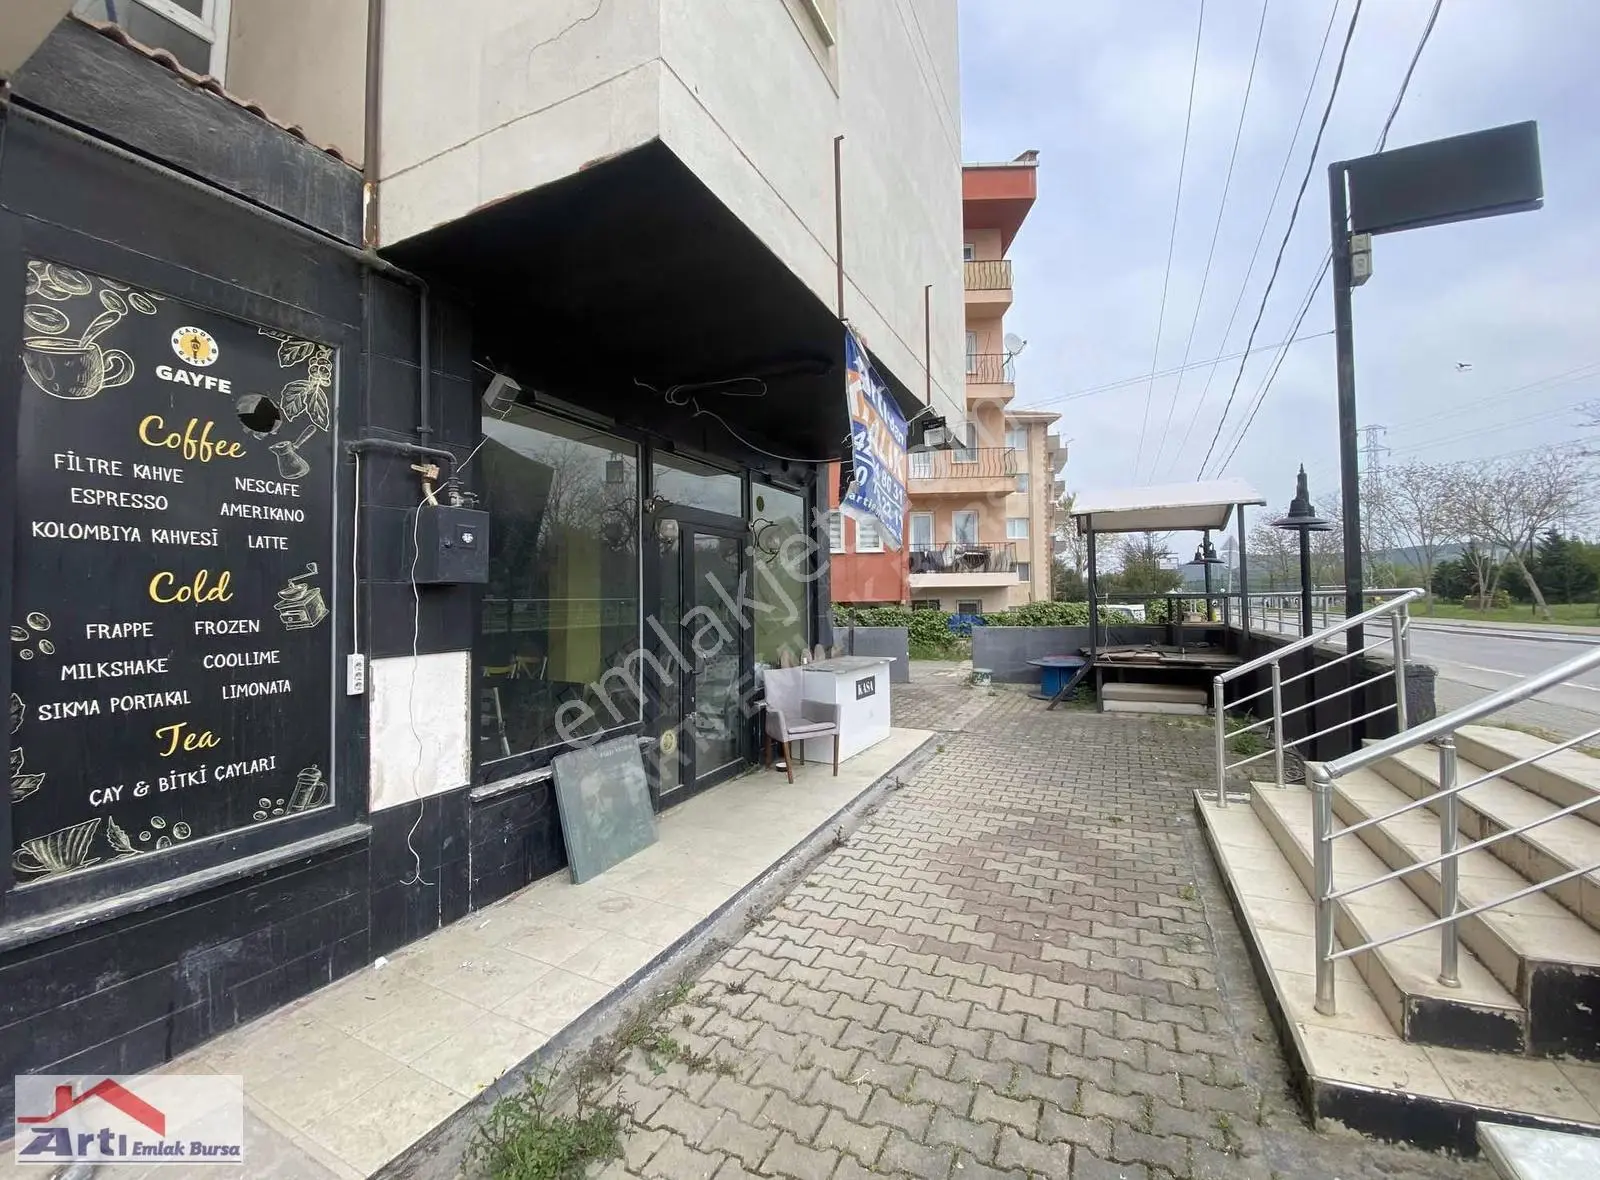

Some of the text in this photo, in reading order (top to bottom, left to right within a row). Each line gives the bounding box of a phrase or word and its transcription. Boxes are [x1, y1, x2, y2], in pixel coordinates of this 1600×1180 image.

[156, 365, 231, 394] GAYFE
[139, 415, 246, 462] Coffee
[54, 451, 184, 484] FİLTRE KAHVE
[71, 487, 168, 510] ESPRESSO
[235, 477, 300, 498] NESCAFE
[220, 503, 305, 523] AMERIKANO
[32, 521, 218, 546] KOLOMBIYA KAHVESİ
[248, 534, 288, 550] LATTE
[149, 569, 233, 603] Cold
[86, 622, 154, 639] FRAPPE
[195, 620, 260, 635] FROZEN
[61, 658, 169, 681] MILKSHAKE
[203, 650, 280, 669] COOLLIME
[222, 680, 291, 700] LIMONATA
[38, 690, 191, 721] SIKMA PORTAKAL
[155, 722, 221, 757] Tea
[89, 756, 276, 807] ÇAY & BİTKİ ÇAYLARI
